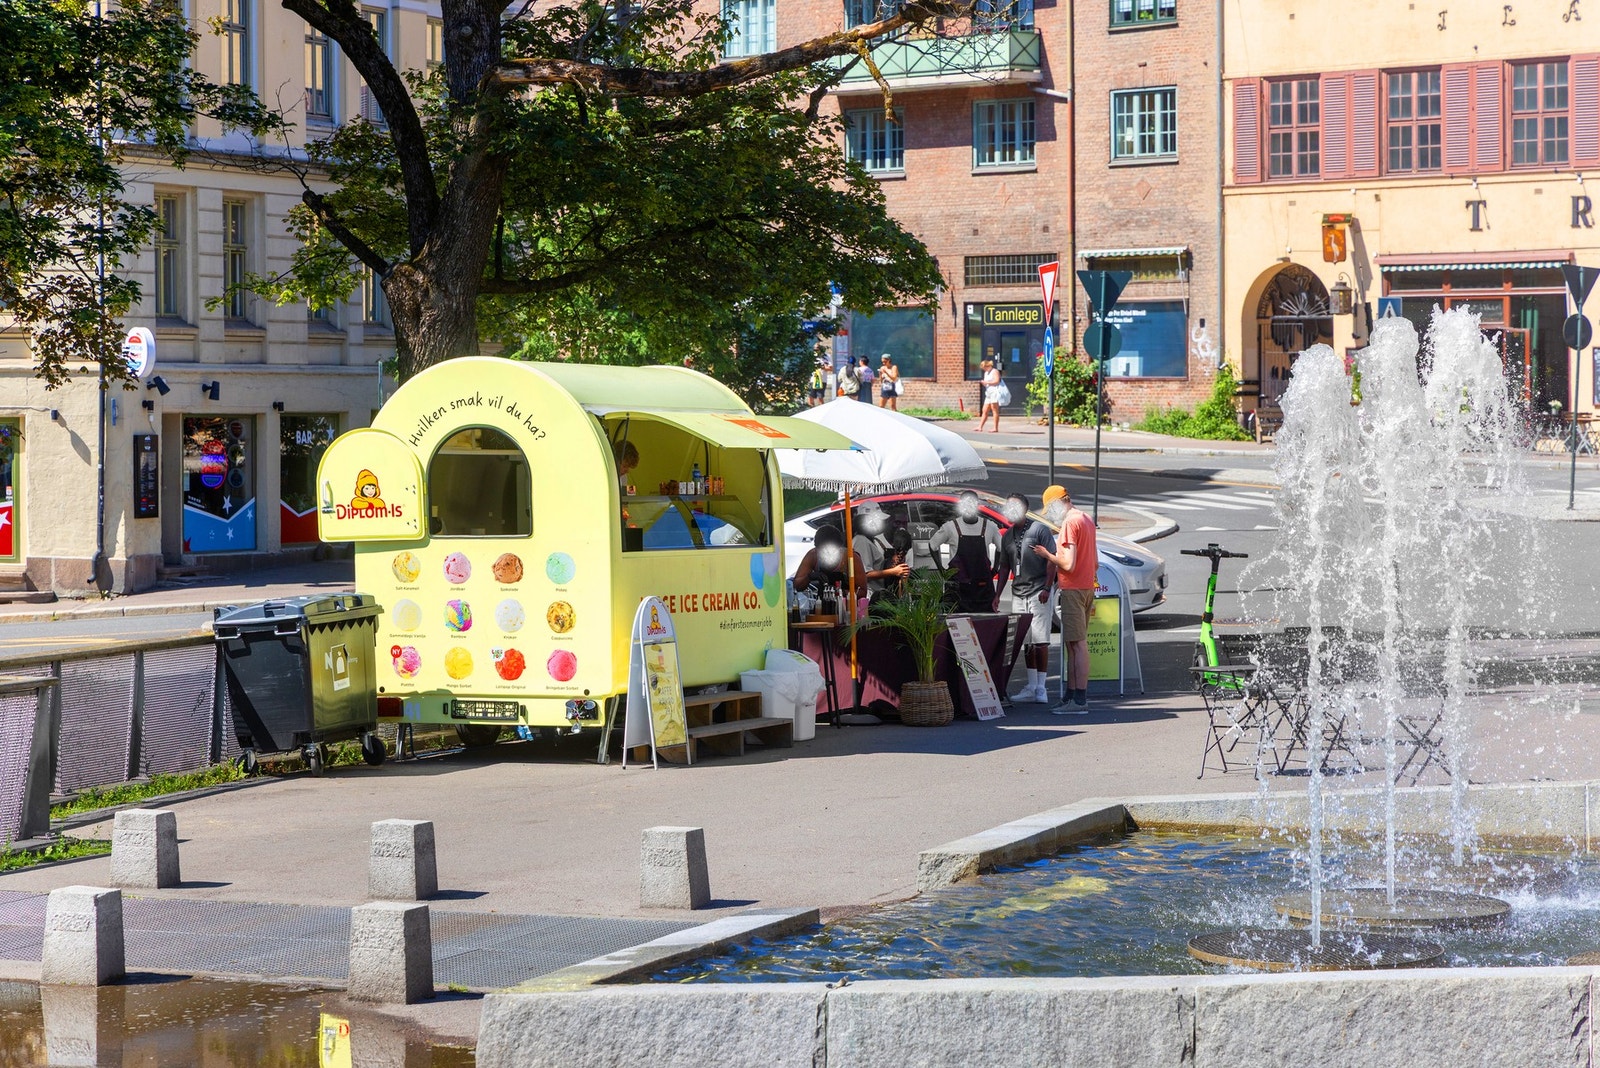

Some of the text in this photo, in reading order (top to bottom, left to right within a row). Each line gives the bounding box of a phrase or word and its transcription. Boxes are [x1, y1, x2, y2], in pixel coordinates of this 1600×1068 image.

[988, 307, 1039, 324] Tannlege
[409, 391, 546, 447] Hvilken smak vil du ha?
[296, 430, 314, 445] BAR
[680, 594, 699, 614] ICE
[702, 592, 740, 612] CREAM
[743, 591, 761, 610] CO.
[392, 648, 401, 656] NY
[1100, 647, 1116, 656] jobb
